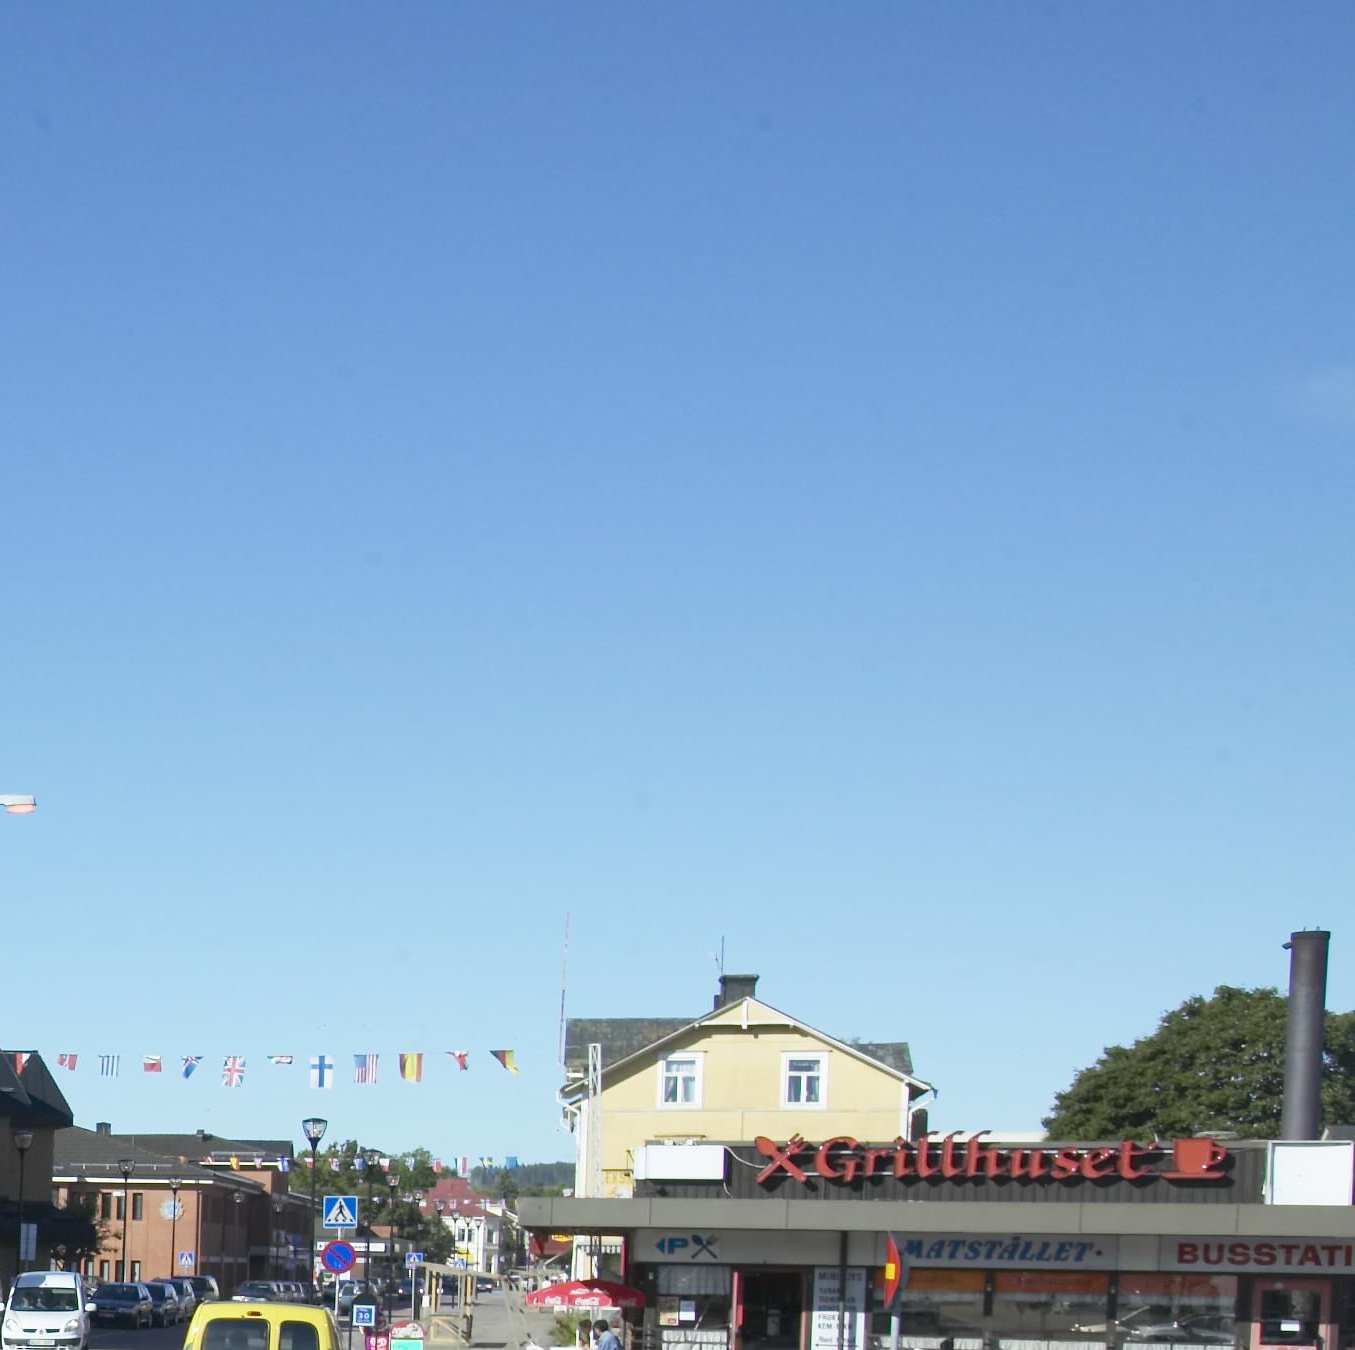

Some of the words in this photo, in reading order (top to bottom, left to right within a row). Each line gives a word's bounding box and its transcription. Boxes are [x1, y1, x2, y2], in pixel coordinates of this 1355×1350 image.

[813, 1130, 1158, 1182] Grillhuset
[667, 1238, 689, 1254] P
[1177, 1242, 1352, 1266] BUSSTATI
